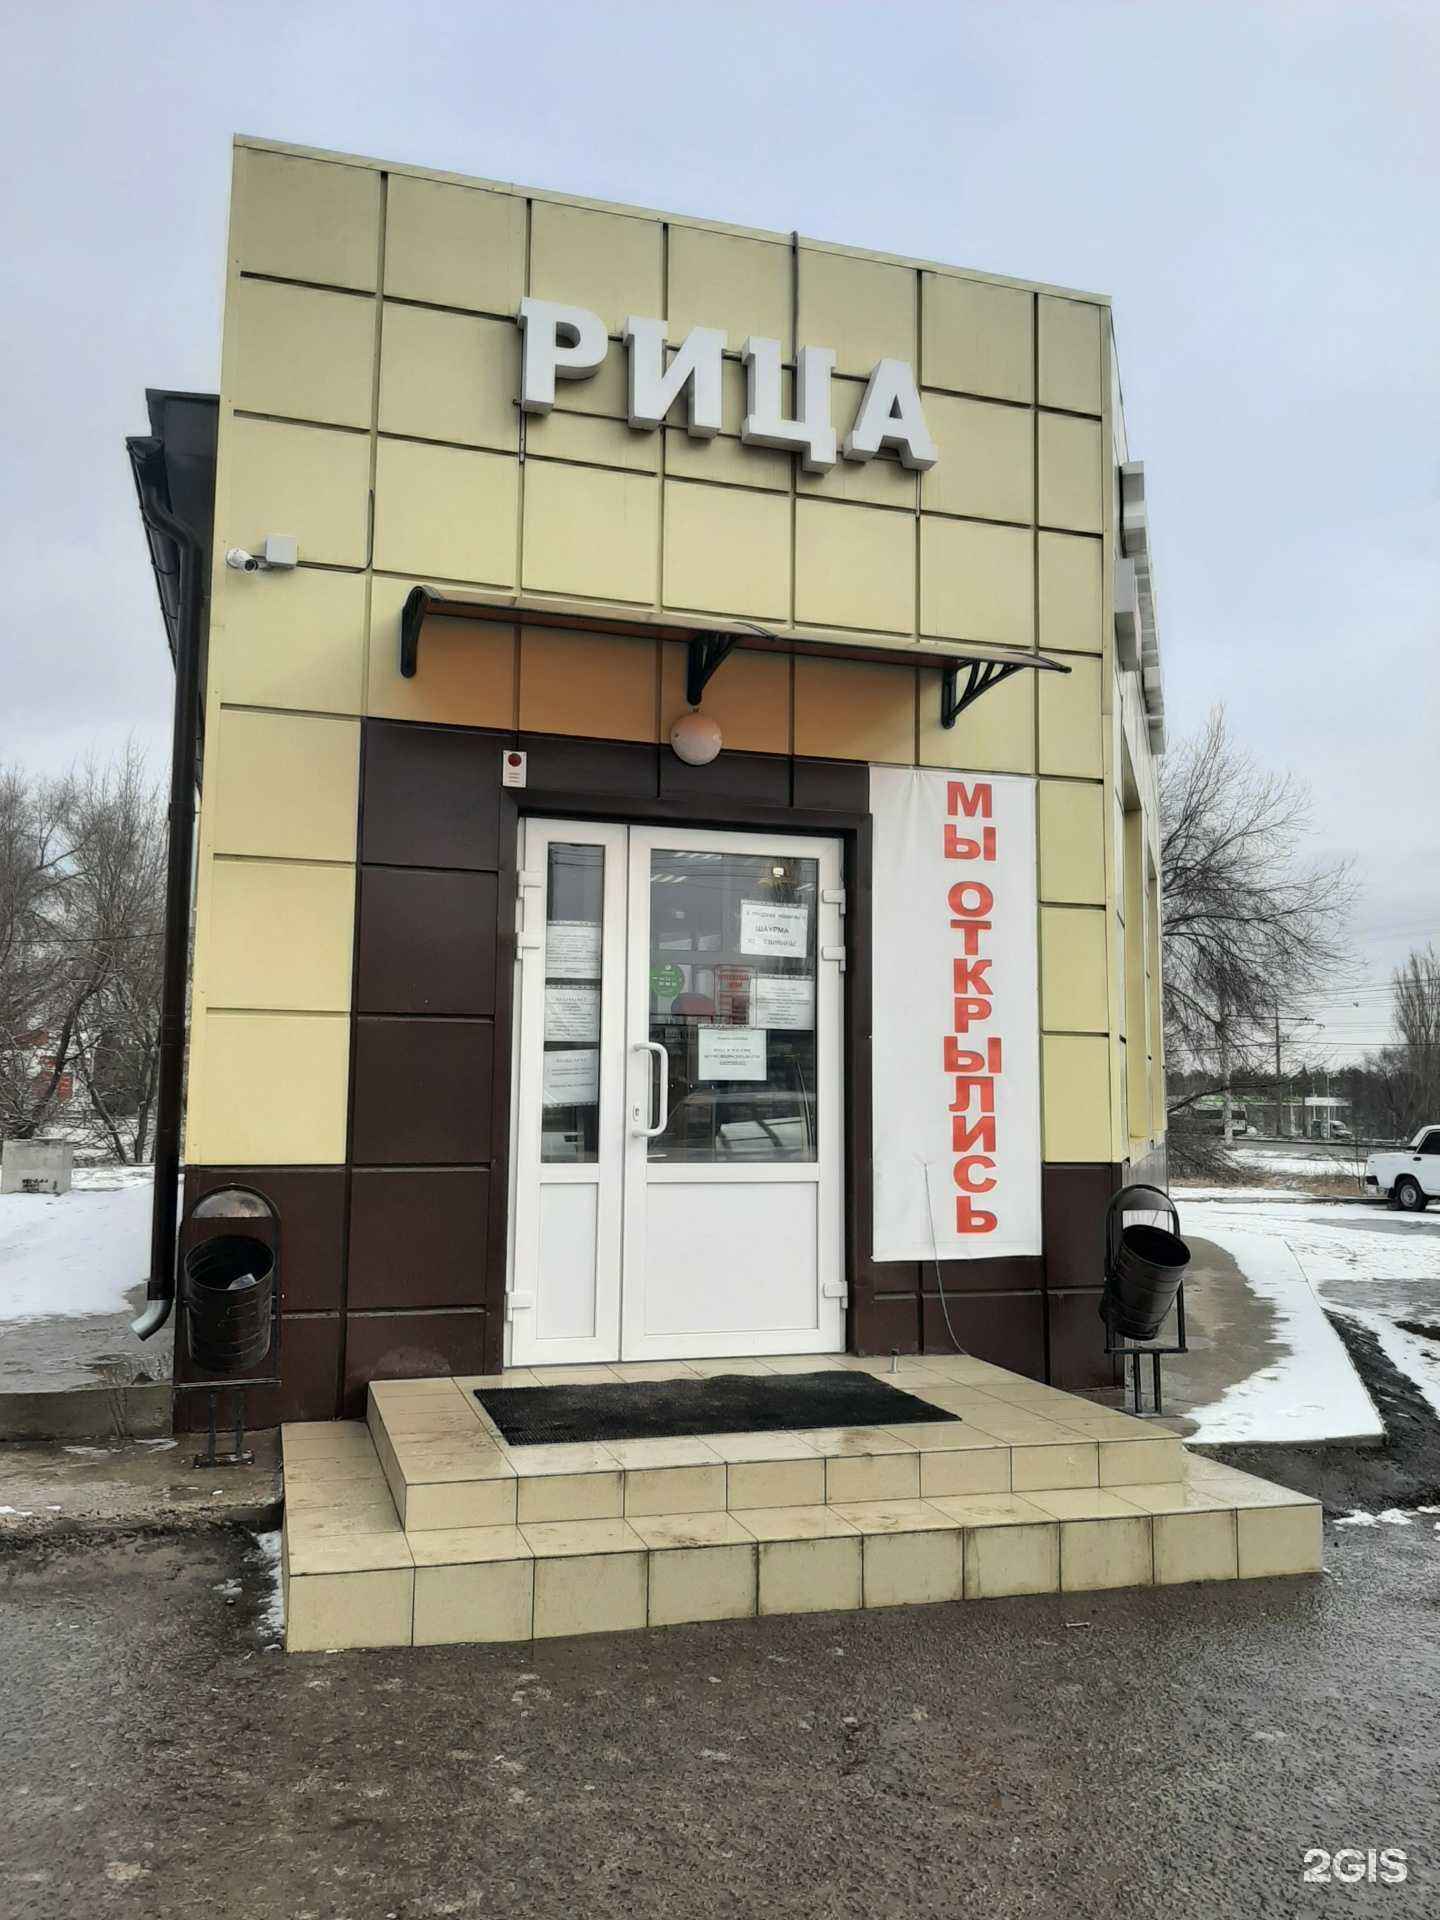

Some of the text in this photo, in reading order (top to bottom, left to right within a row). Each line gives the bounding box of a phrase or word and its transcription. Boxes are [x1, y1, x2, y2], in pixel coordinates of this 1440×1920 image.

[518, 297, 938, 471] РИЦА
[943, 780, 1003, 1236] МЫ ОТКРЫЛИСЬ
